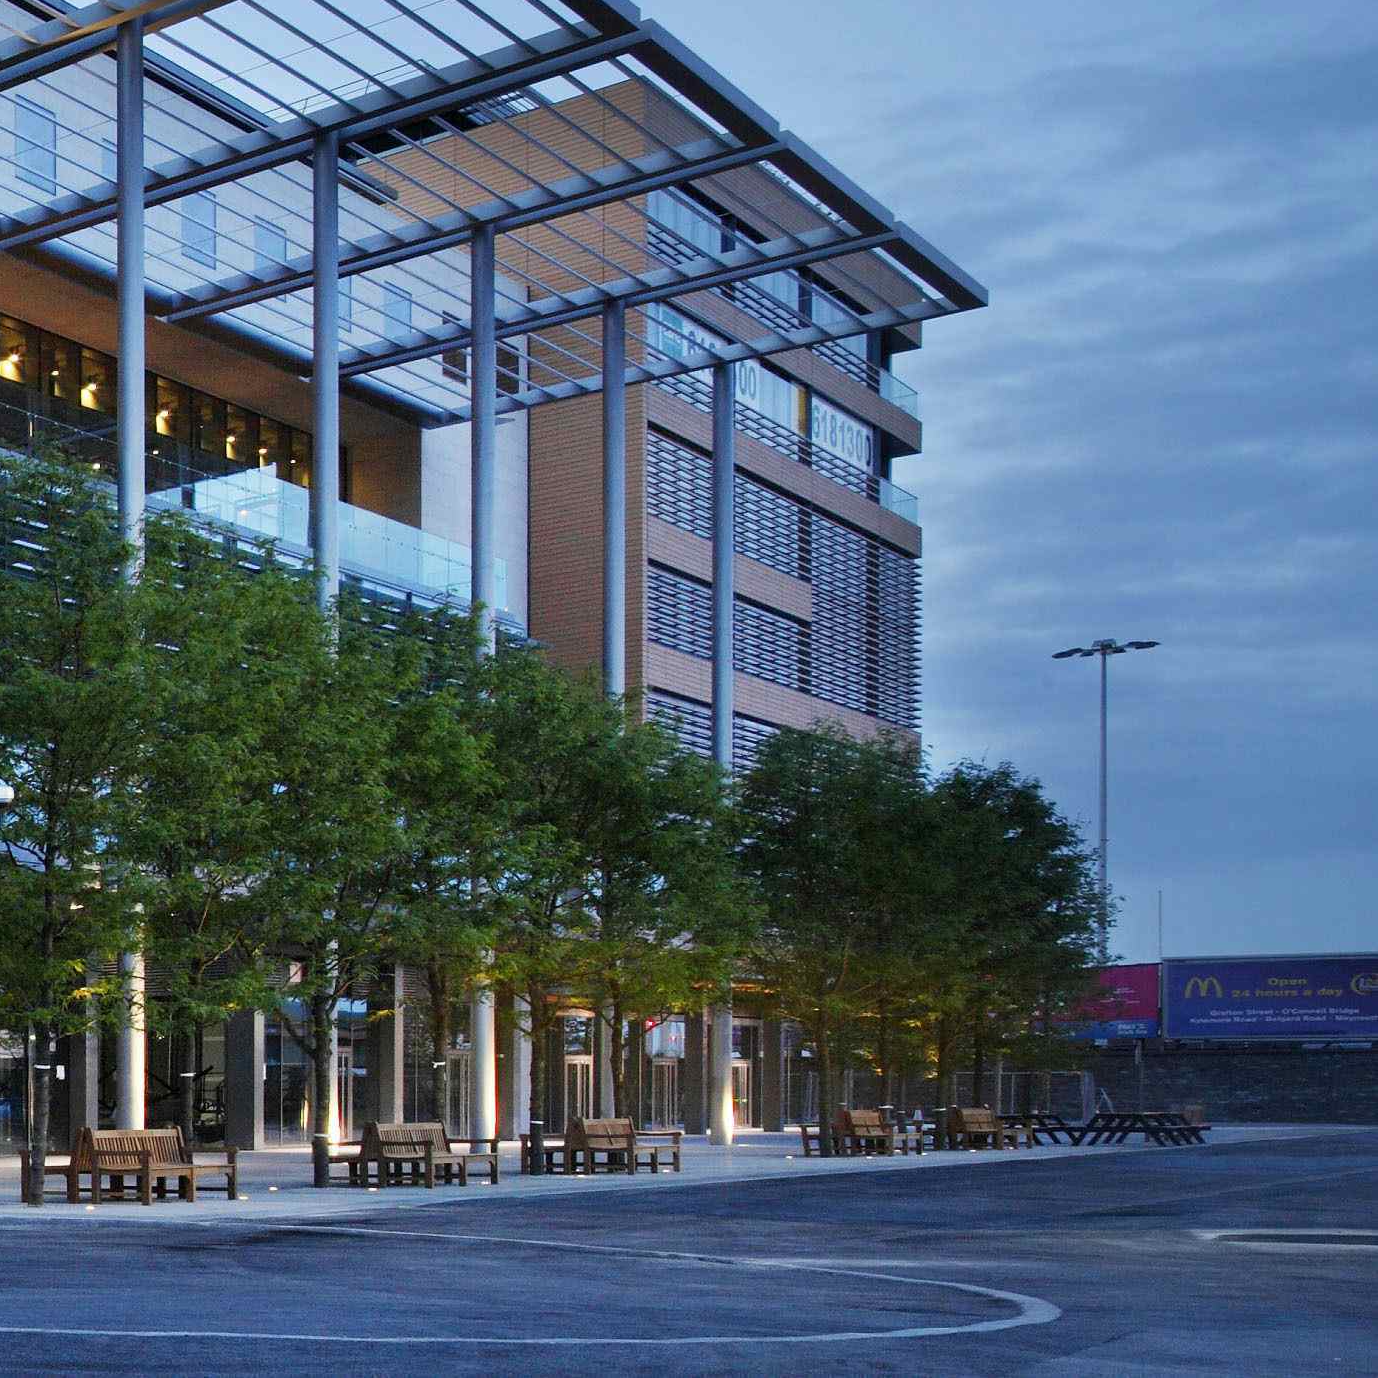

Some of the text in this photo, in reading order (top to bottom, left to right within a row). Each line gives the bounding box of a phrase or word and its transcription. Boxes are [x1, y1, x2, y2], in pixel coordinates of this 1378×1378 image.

[1267, 977, 1308, 988] Open
[1253, 987, 1299, 998] hours
[1316, 986, 1343, 999] day
